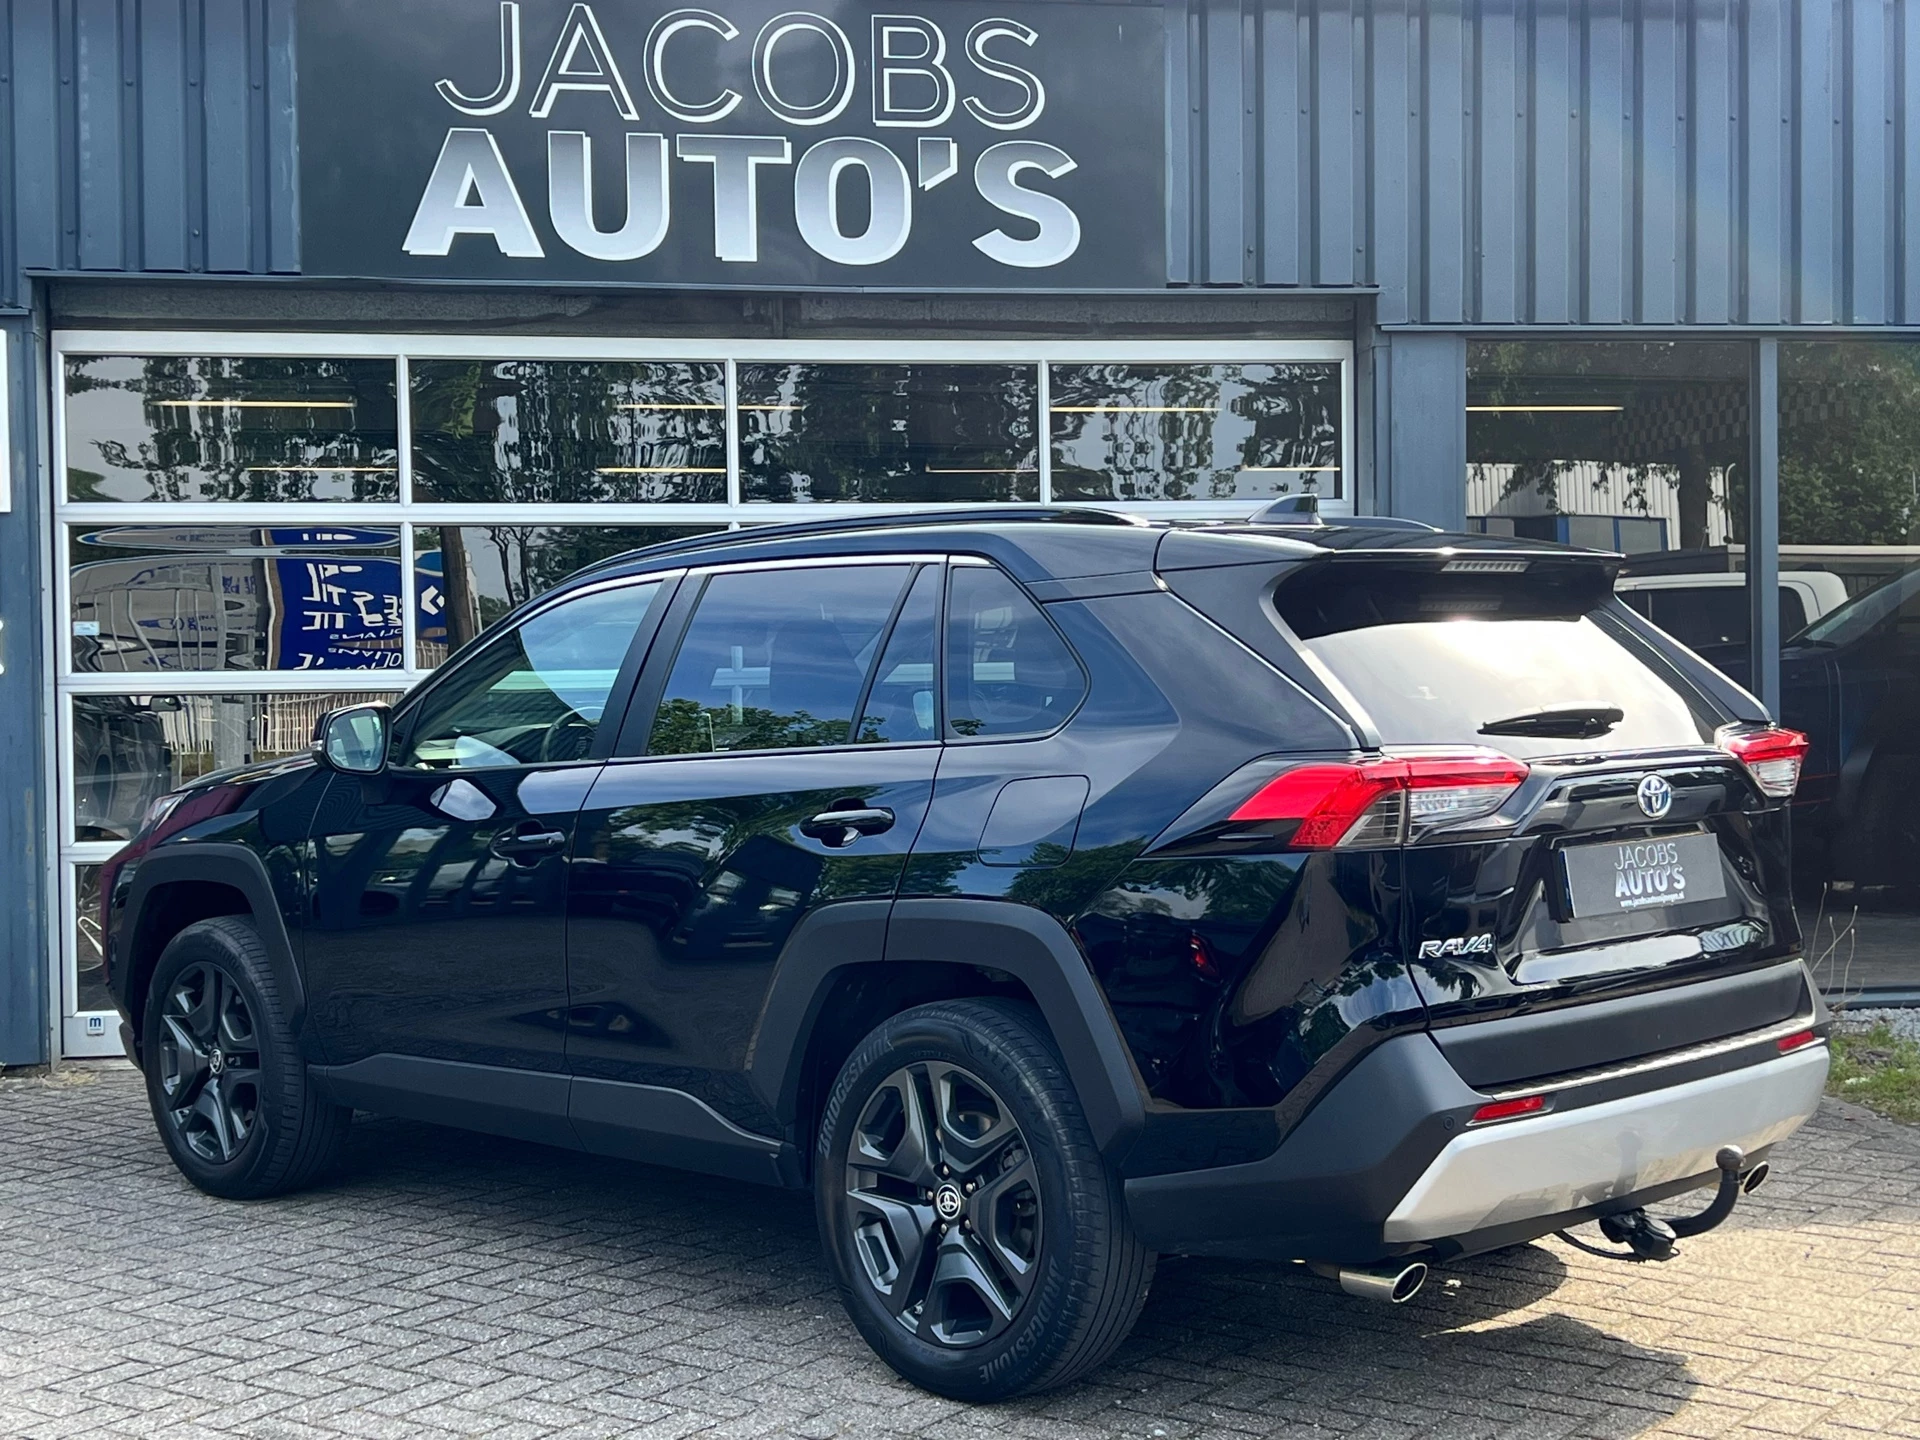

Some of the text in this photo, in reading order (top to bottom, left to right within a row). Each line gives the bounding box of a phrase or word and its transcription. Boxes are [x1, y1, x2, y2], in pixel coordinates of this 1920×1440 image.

[435, 1, 1045, 130] JACOBS
[402, 127, 1081, 268] AUTO'S
[1614, 842, 1679, 870] JACOBS
[1615, 863, 1686, 897] AUTO'S
[1418, 933, 1493, 959] RAV4
